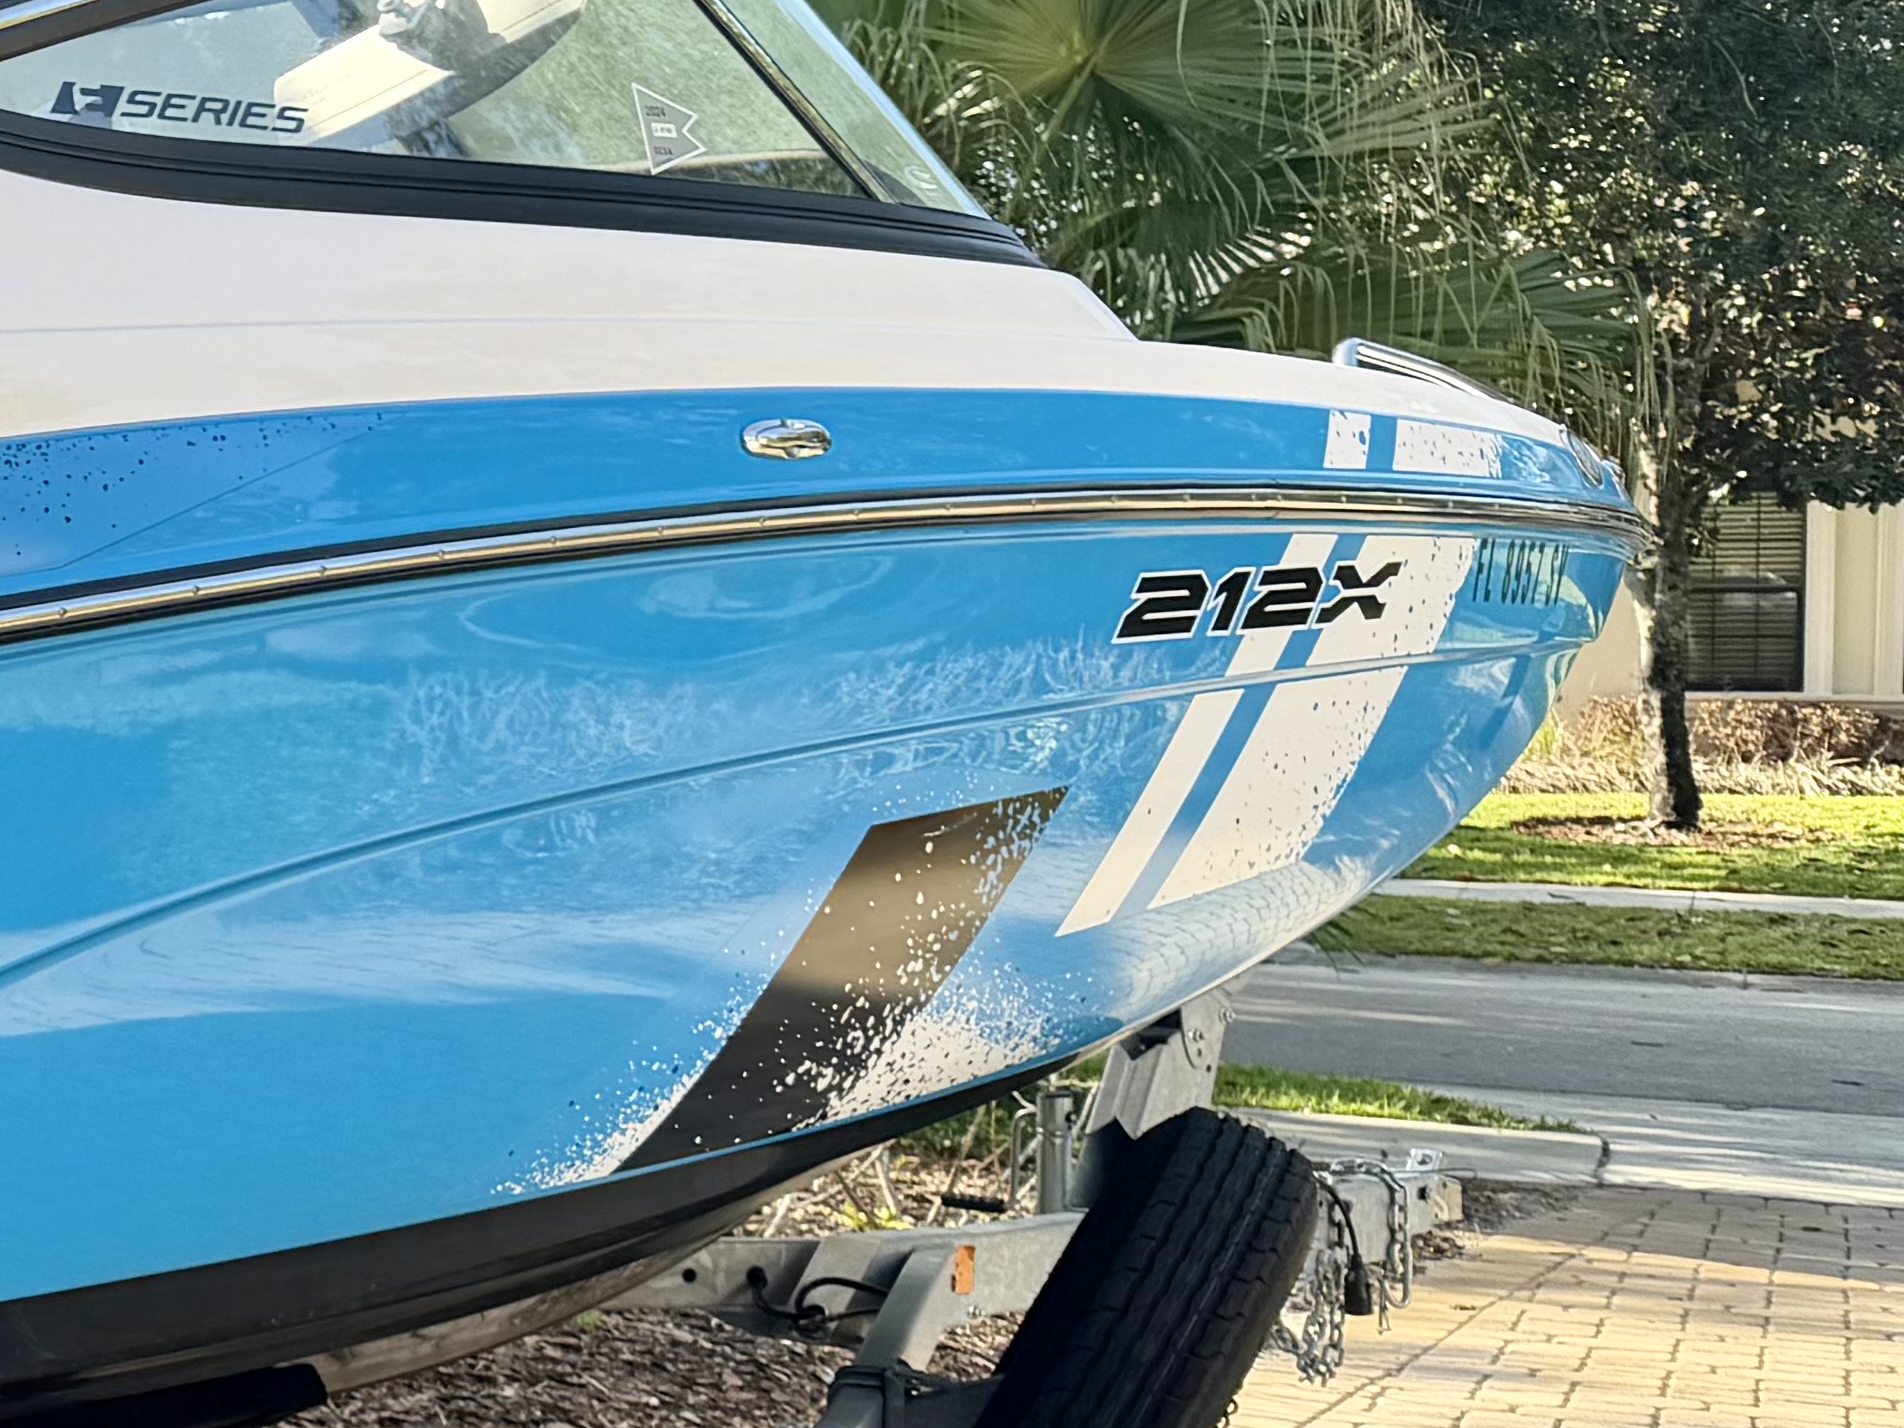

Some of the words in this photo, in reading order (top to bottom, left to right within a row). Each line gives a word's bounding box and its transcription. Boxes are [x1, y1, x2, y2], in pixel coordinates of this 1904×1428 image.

[119, 89, 309, 134] SERIES
[1110, 560, 1404, 645] 212X
[1472, 538, 1496, 603] FL
